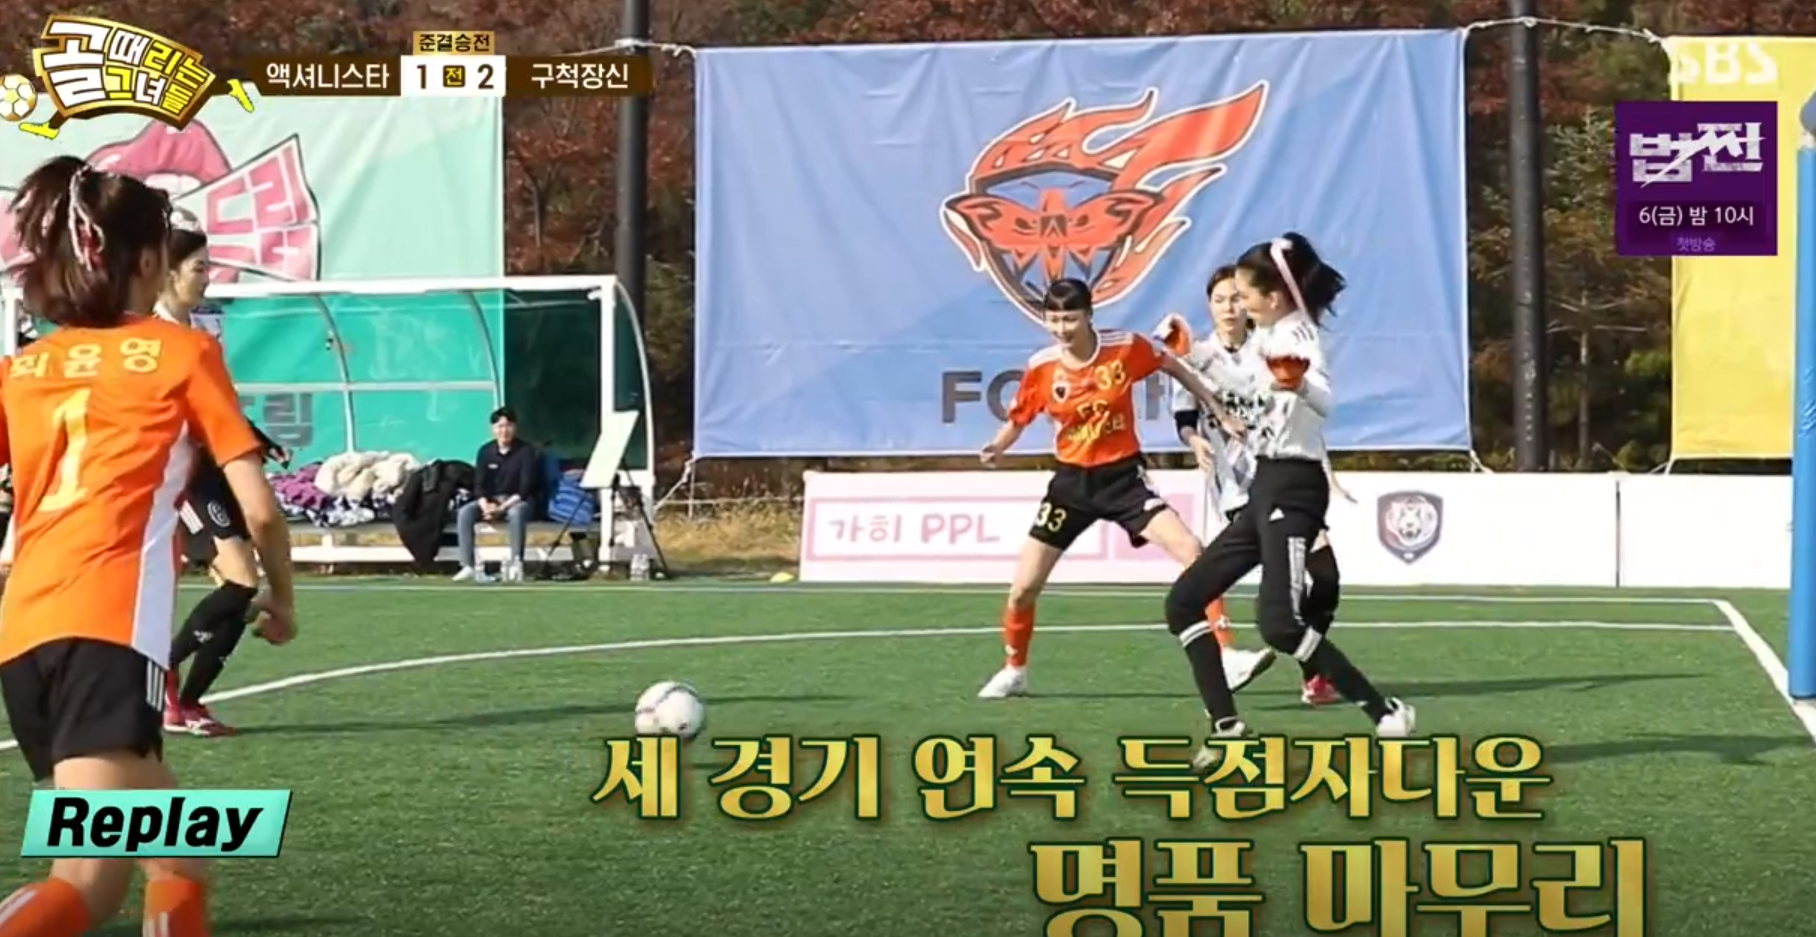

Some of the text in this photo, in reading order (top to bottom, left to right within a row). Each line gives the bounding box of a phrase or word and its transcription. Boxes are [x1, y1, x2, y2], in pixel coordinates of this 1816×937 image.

[1094, 358, 1126, 391] 33
[37, 386, 92, 514] 1
[829, 513, 1001, 545] 가히 PPL
[1036, 501, 1067, 532] 33
